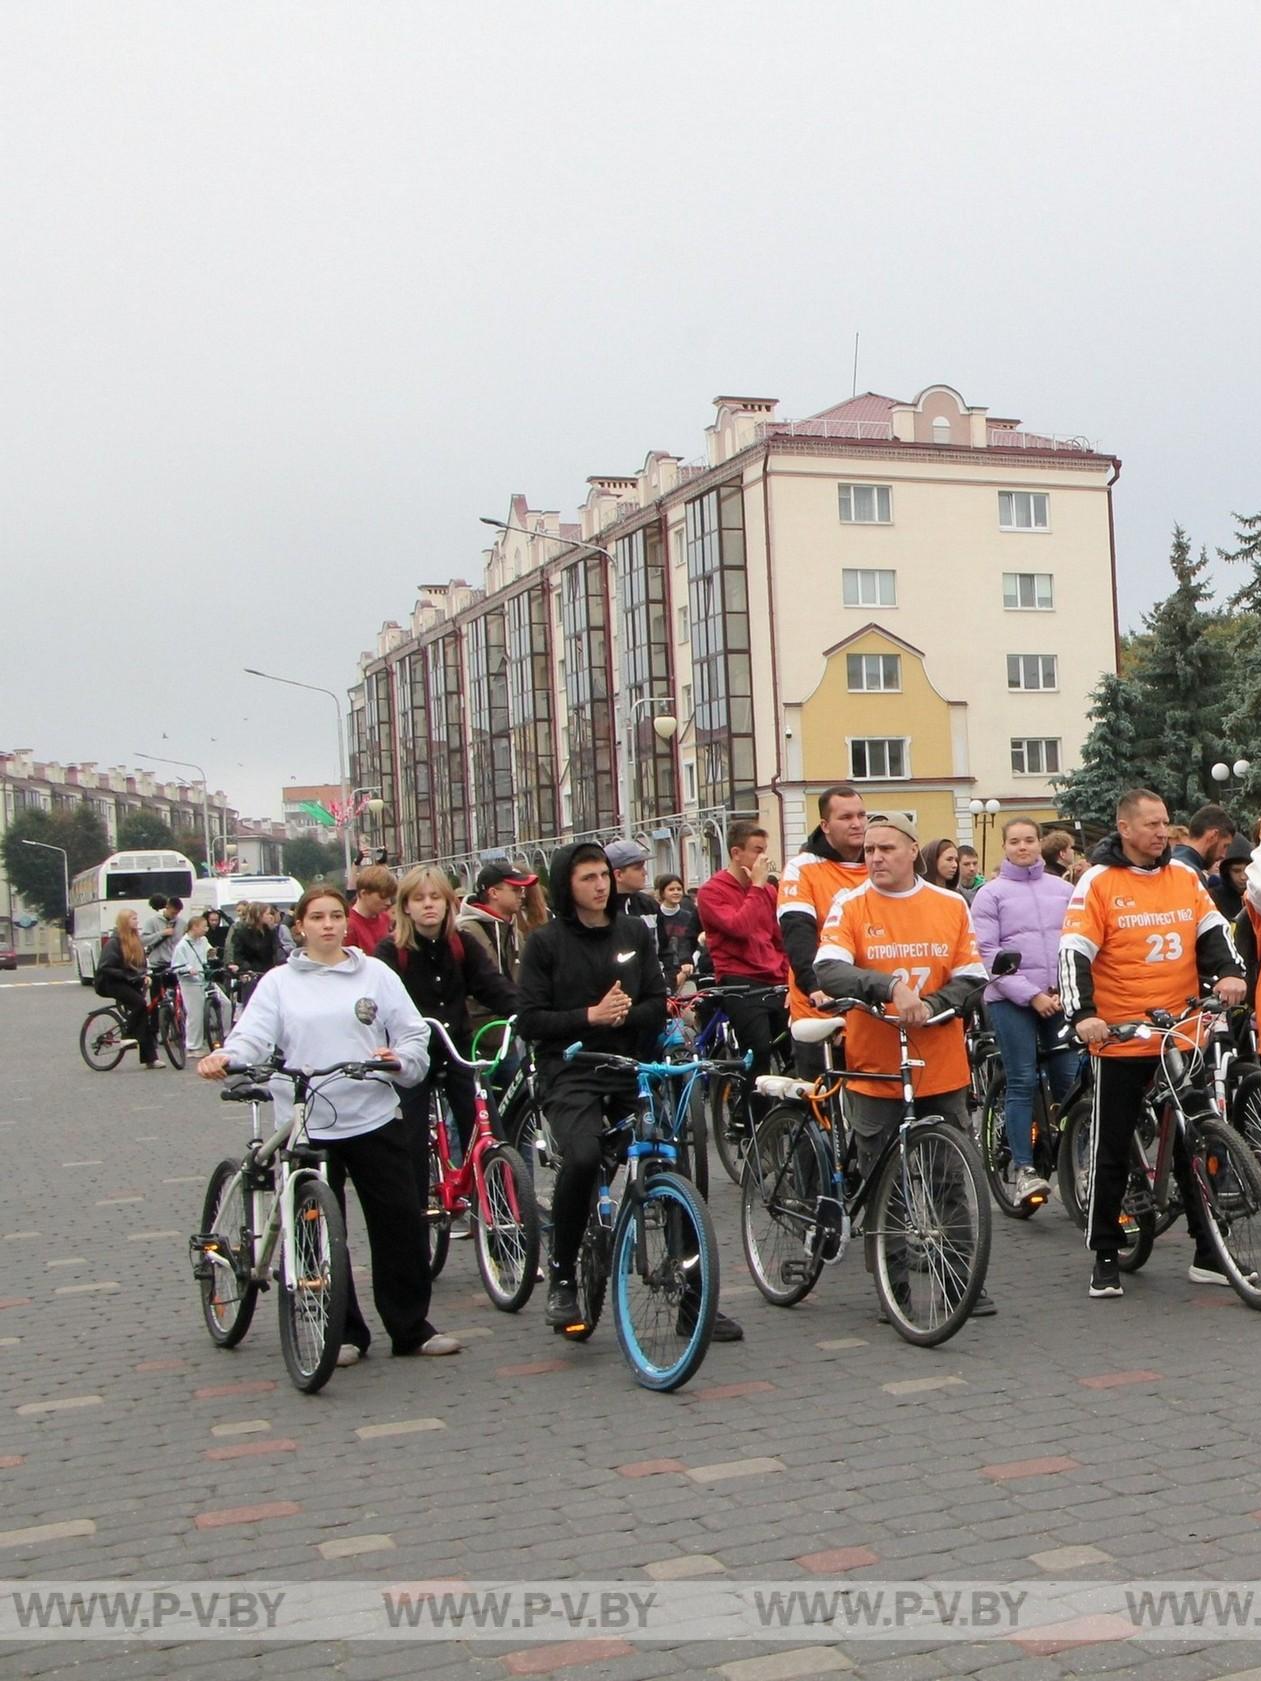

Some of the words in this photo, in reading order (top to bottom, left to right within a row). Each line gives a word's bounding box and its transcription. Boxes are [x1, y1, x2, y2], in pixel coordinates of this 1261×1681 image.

[783, 885, 798, 897] 14
[1117, 912, 1175, 929] СТРОЙТРЕСТ
[867, 943, 929, 960] СТРОЙТРЕСТ
[930, 943, 949, 957] №2
[1145, 932, 1184, 963] 23
